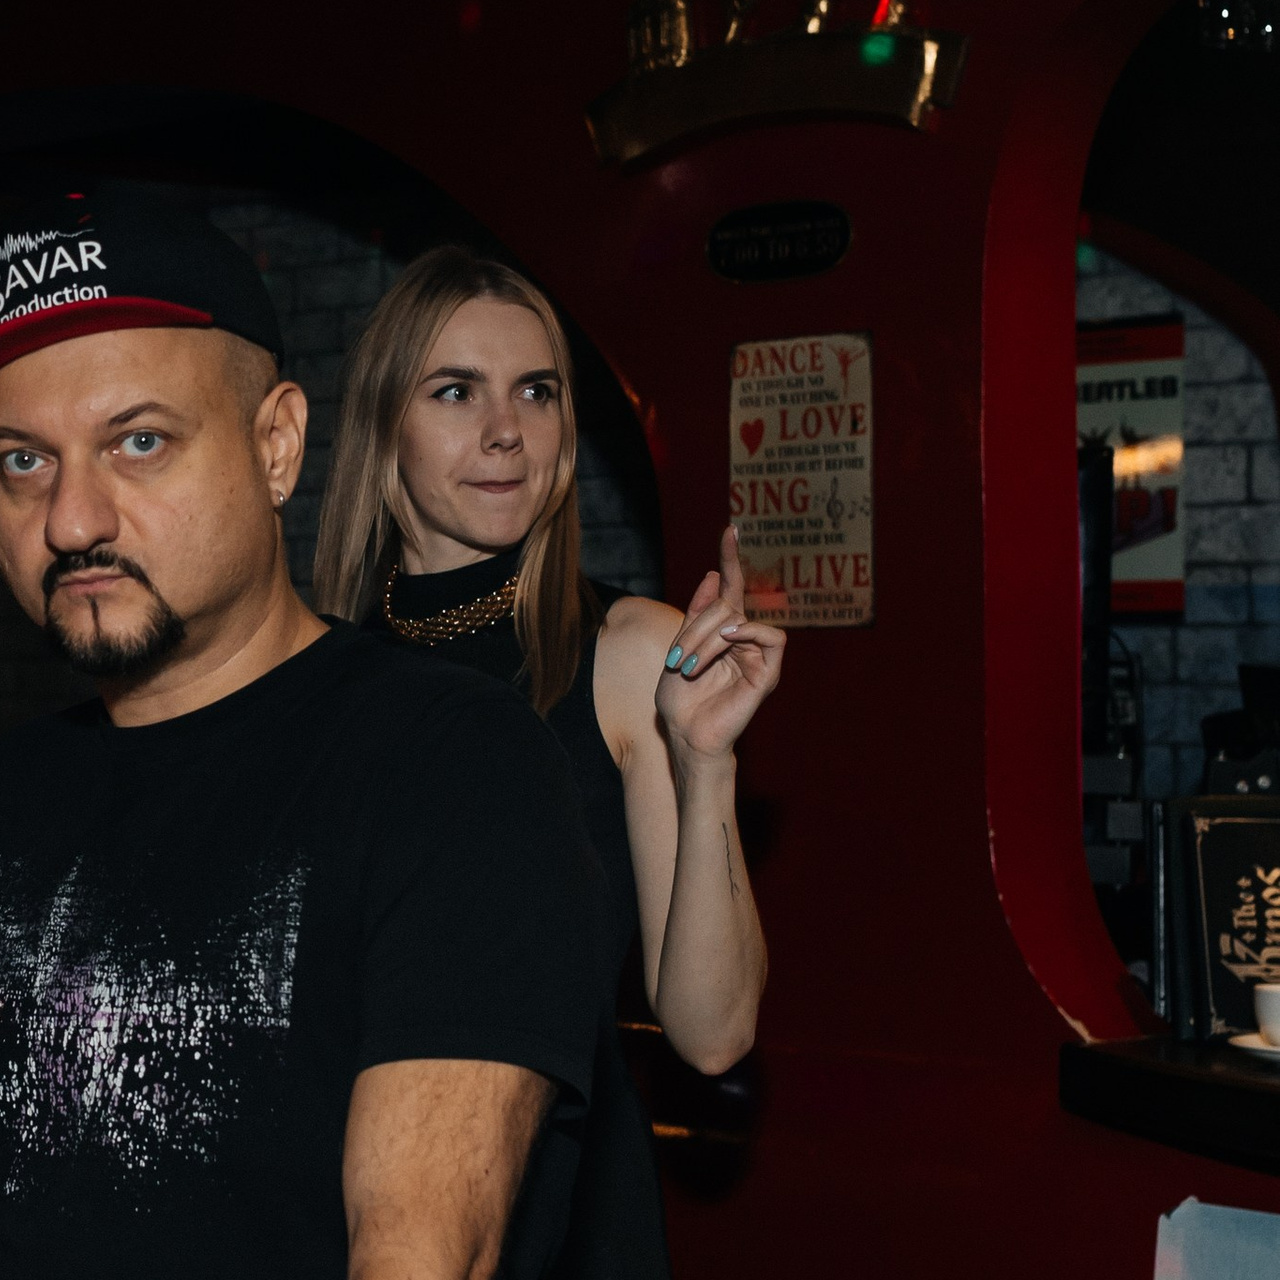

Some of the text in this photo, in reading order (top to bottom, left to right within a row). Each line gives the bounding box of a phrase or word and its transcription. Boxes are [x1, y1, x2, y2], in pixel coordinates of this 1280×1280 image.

[732, 341, 824, 378] DANCE
[780, 403, 866, 441] LOVE
[730, 477, 810, 516] SING
[791, 553, 870, 589] LIVE
